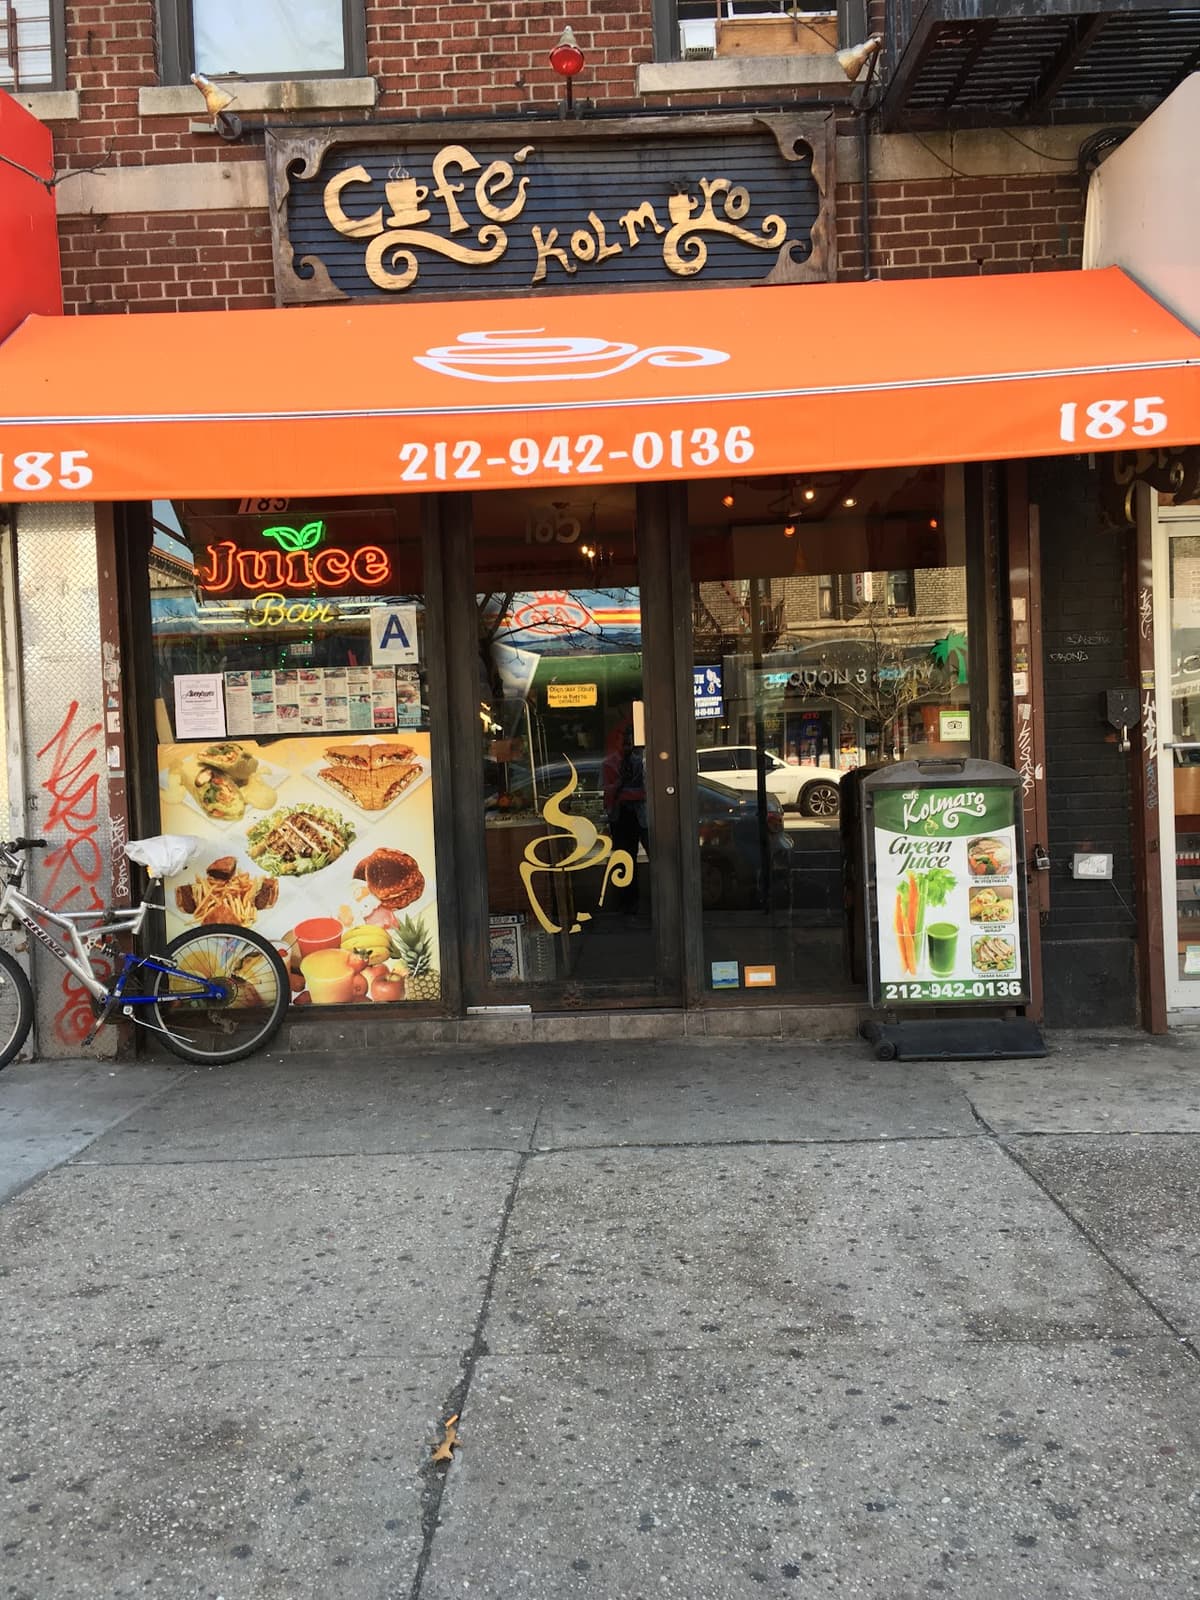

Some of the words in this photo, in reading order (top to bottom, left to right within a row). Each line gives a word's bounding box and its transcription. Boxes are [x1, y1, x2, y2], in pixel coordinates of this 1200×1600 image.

[1059, 397, 1168, 442] 185
[398, 426, 755, 482] 212-942-0136
[193, 541, 389, 591] Juice
[249, 592, 335, 627] Bar
[379, 613, 411, 650] A
[903, 791, 986, 831] Kolmaro
[888, 835, 953, 856] Green
[896, 851, 952, 876] Juice
[22, 917, 67, 958] RHINO
[885, 980, 1022, 999] 212-942-0136
